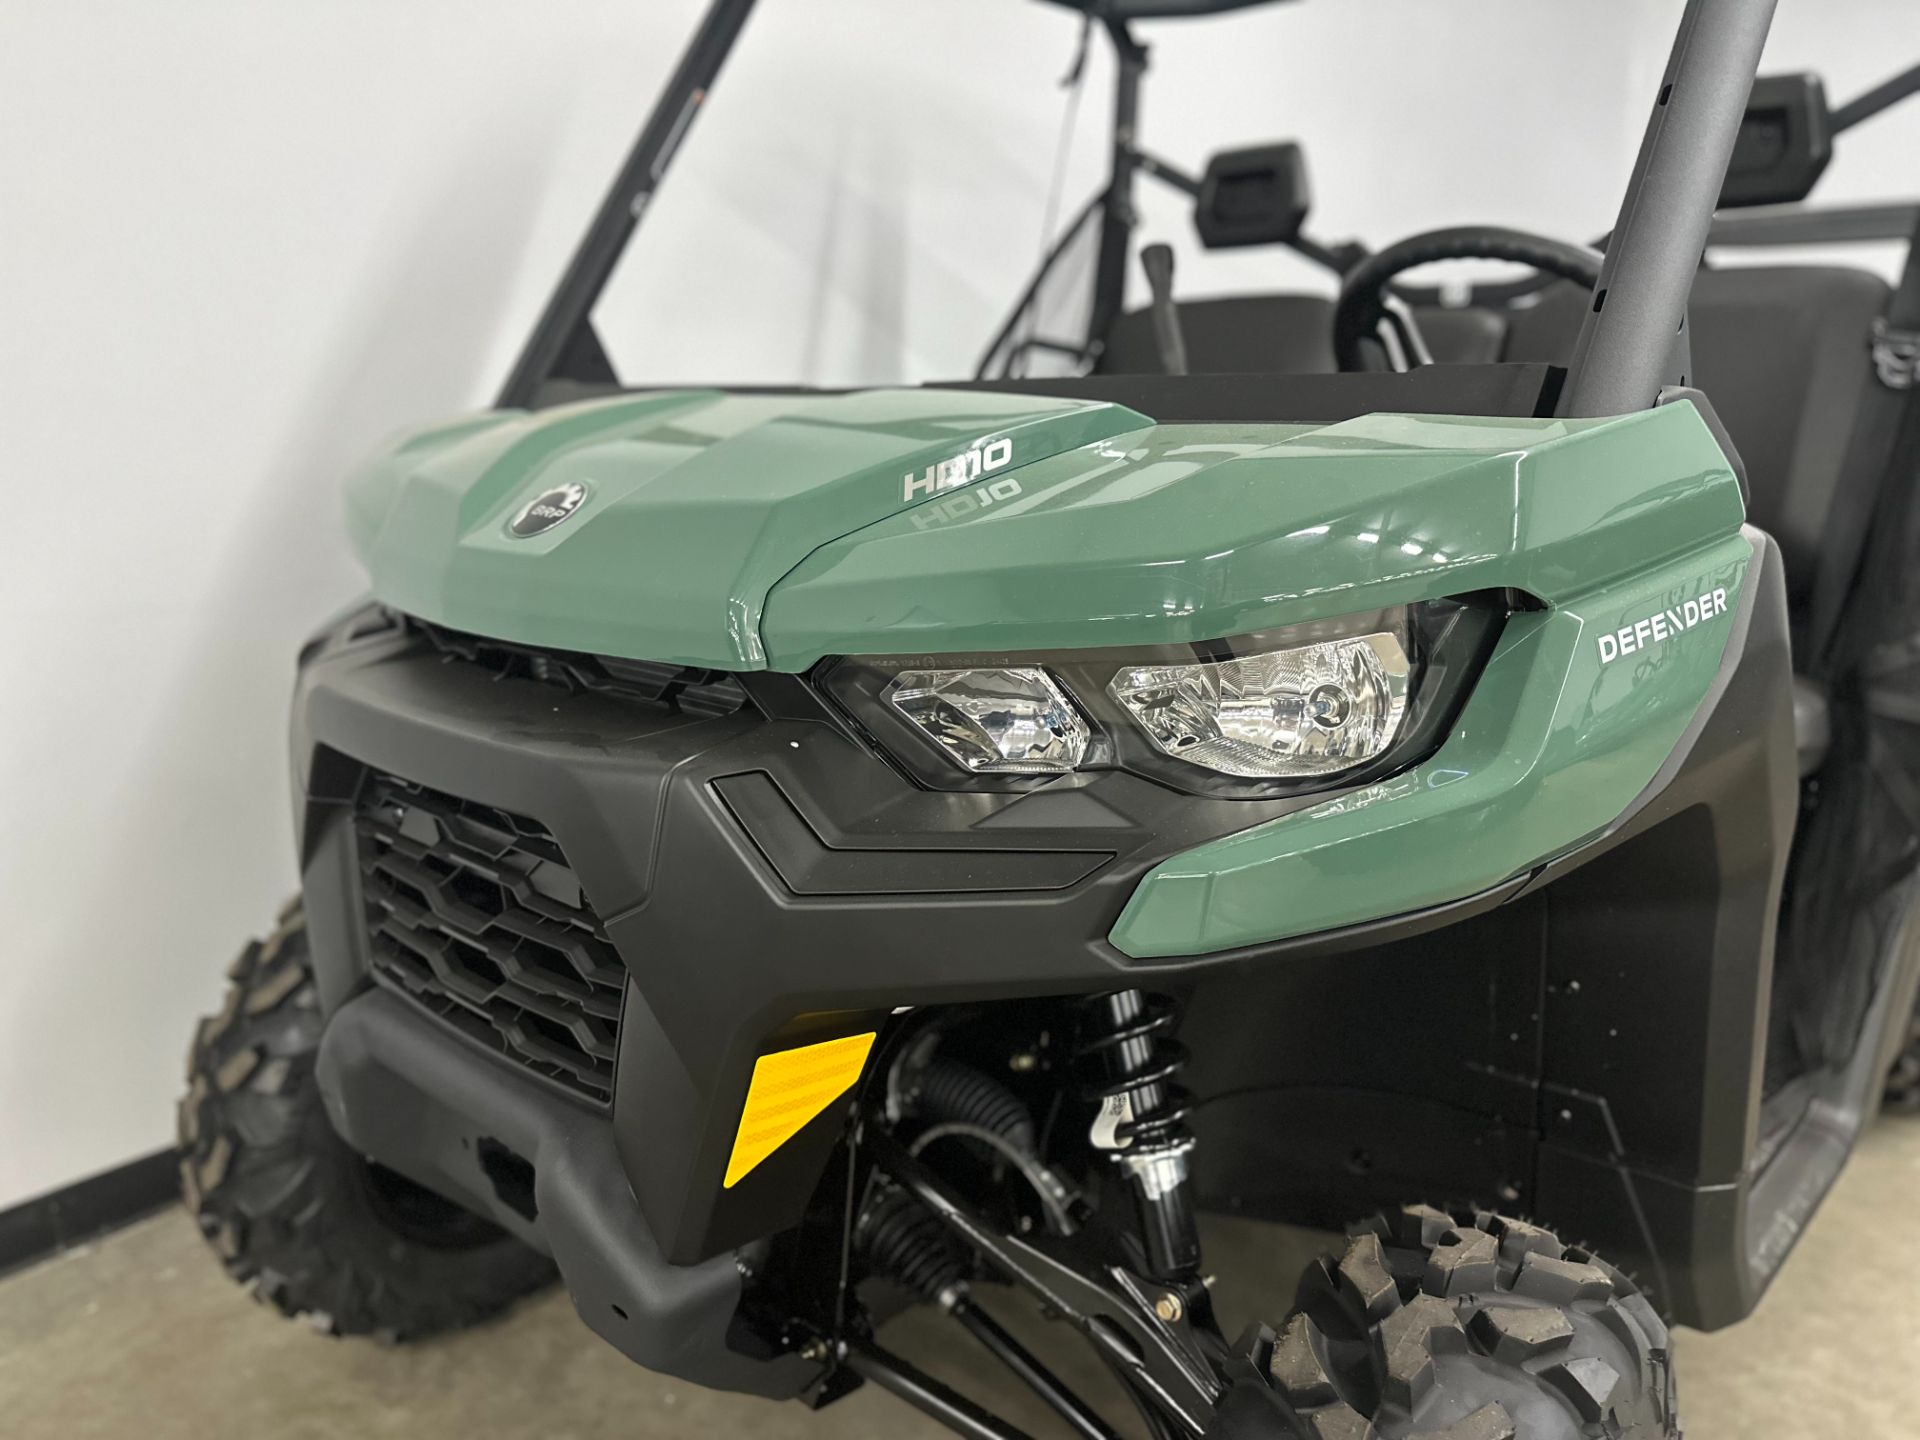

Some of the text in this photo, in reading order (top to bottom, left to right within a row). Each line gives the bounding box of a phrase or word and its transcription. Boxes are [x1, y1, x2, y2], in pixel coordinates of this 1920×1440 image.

[904, 438, 1012, 502] HD10
[531, 505, 566, 518] BRP
[1598, 587, 1727, 664] DEFENDER
